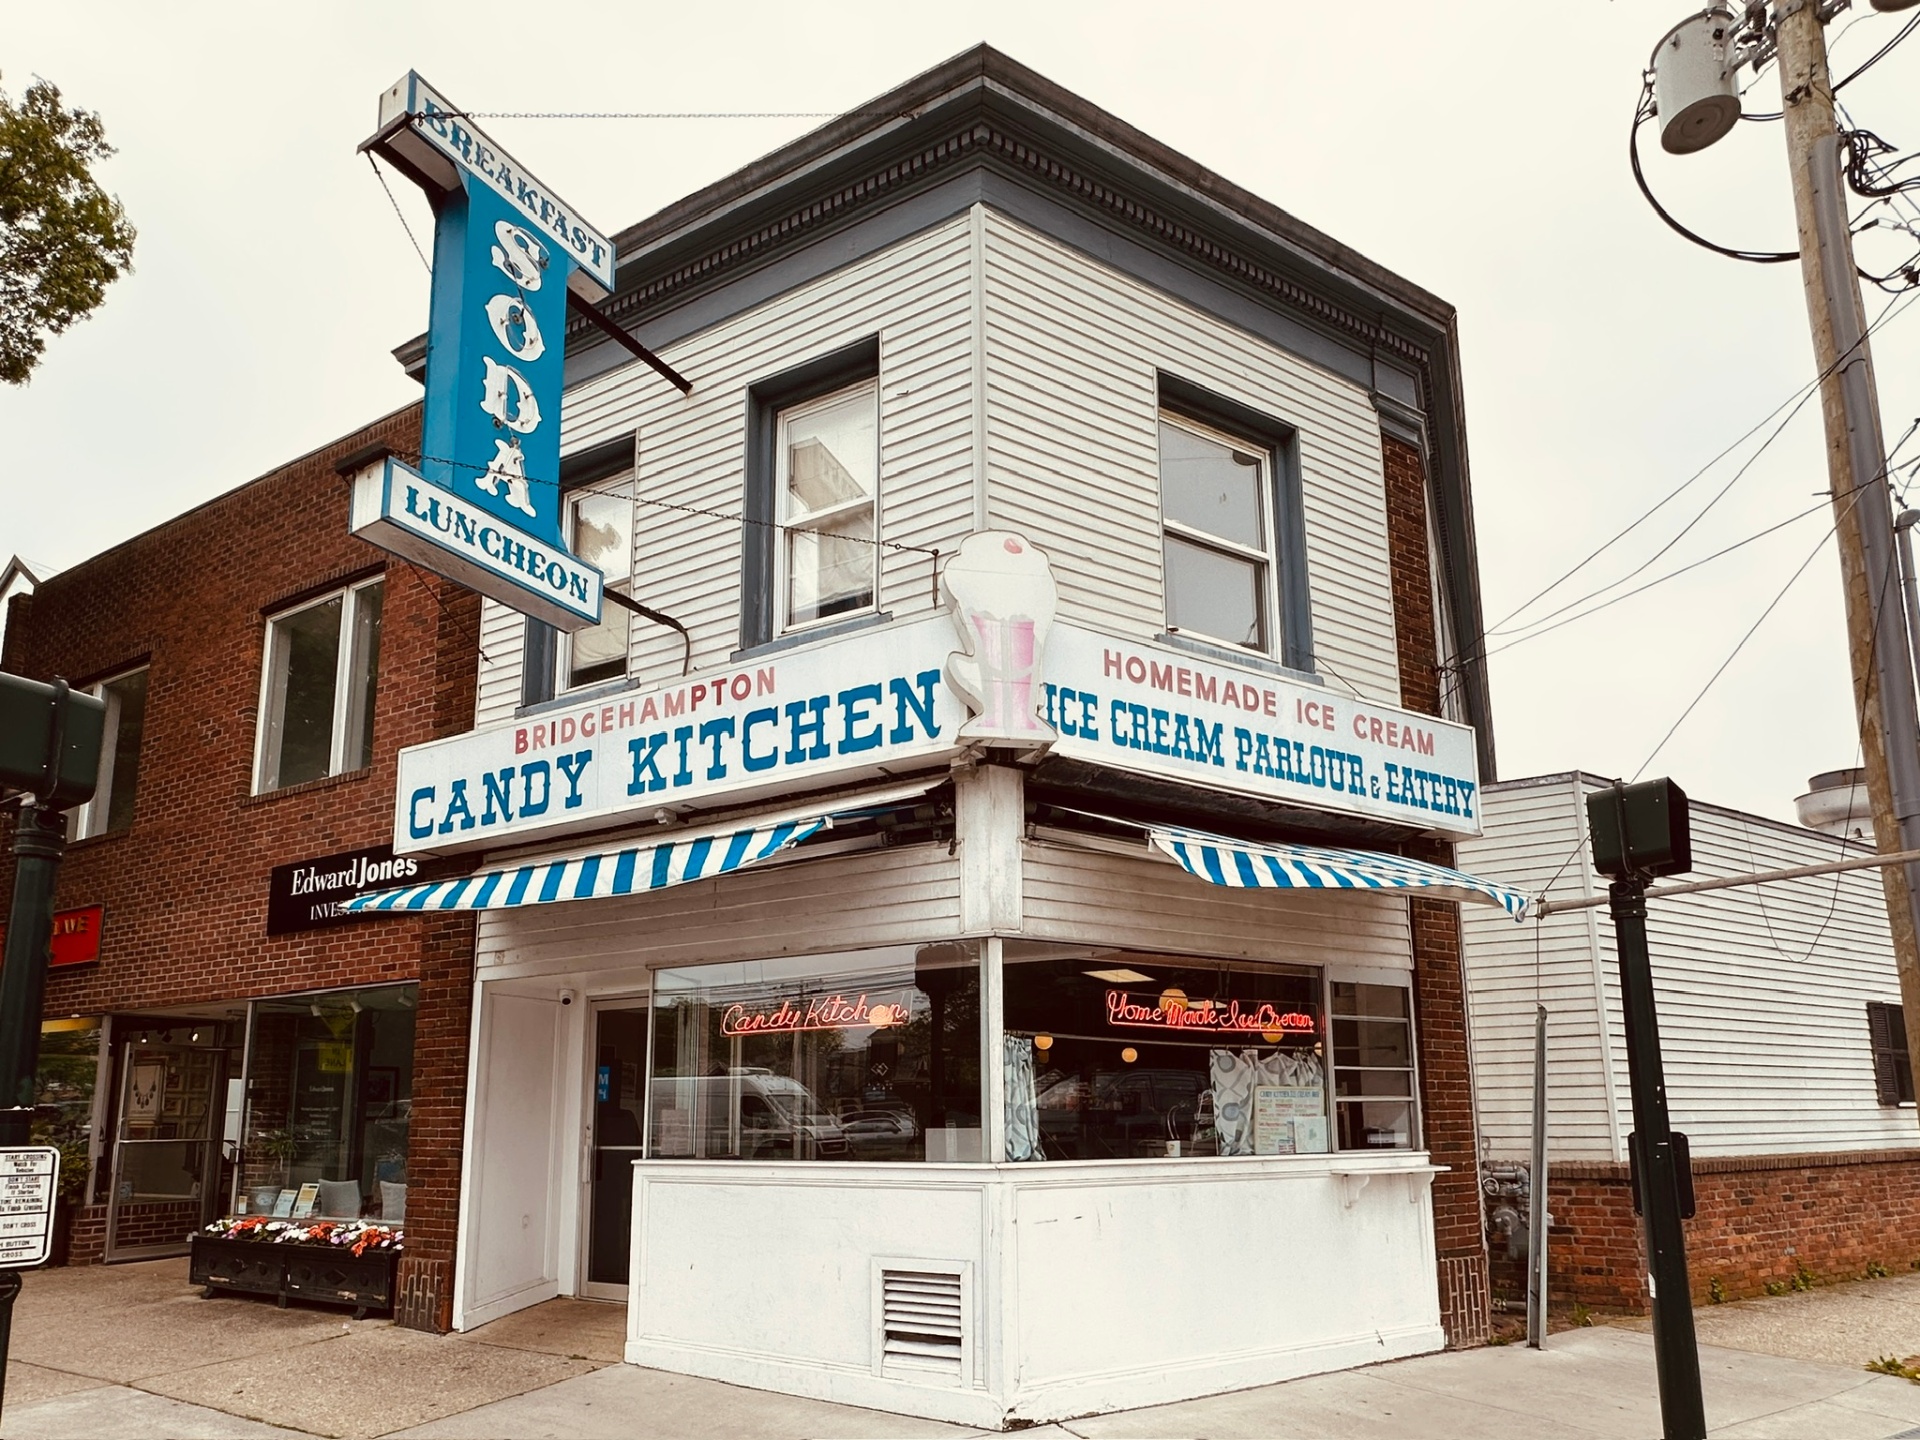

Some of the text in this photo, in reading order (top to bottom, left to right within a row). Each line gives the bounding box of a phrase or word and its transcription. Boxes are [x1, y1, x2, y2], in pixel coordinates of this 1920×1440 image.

[424, 97, 606, 268] BREAKFAST
[474, 219, 551, 518] SODA
[404, 484, 589, 604] LUNCHEON
[408, 668, 942, 840] CANDY KITCHEN
[514, 666, 776, 754] BRIDGEHAMPTON
[1042, 682, 1475, 818] ICE CREAM PARLOUR & EATERY
[1103, 648, 1435, 757] HOMEMADE ICE CREAM
[722, 994, 908, 1034] Candy Kitchen
[1108, 992, 1315, 1030] Home Made Ice Cream
